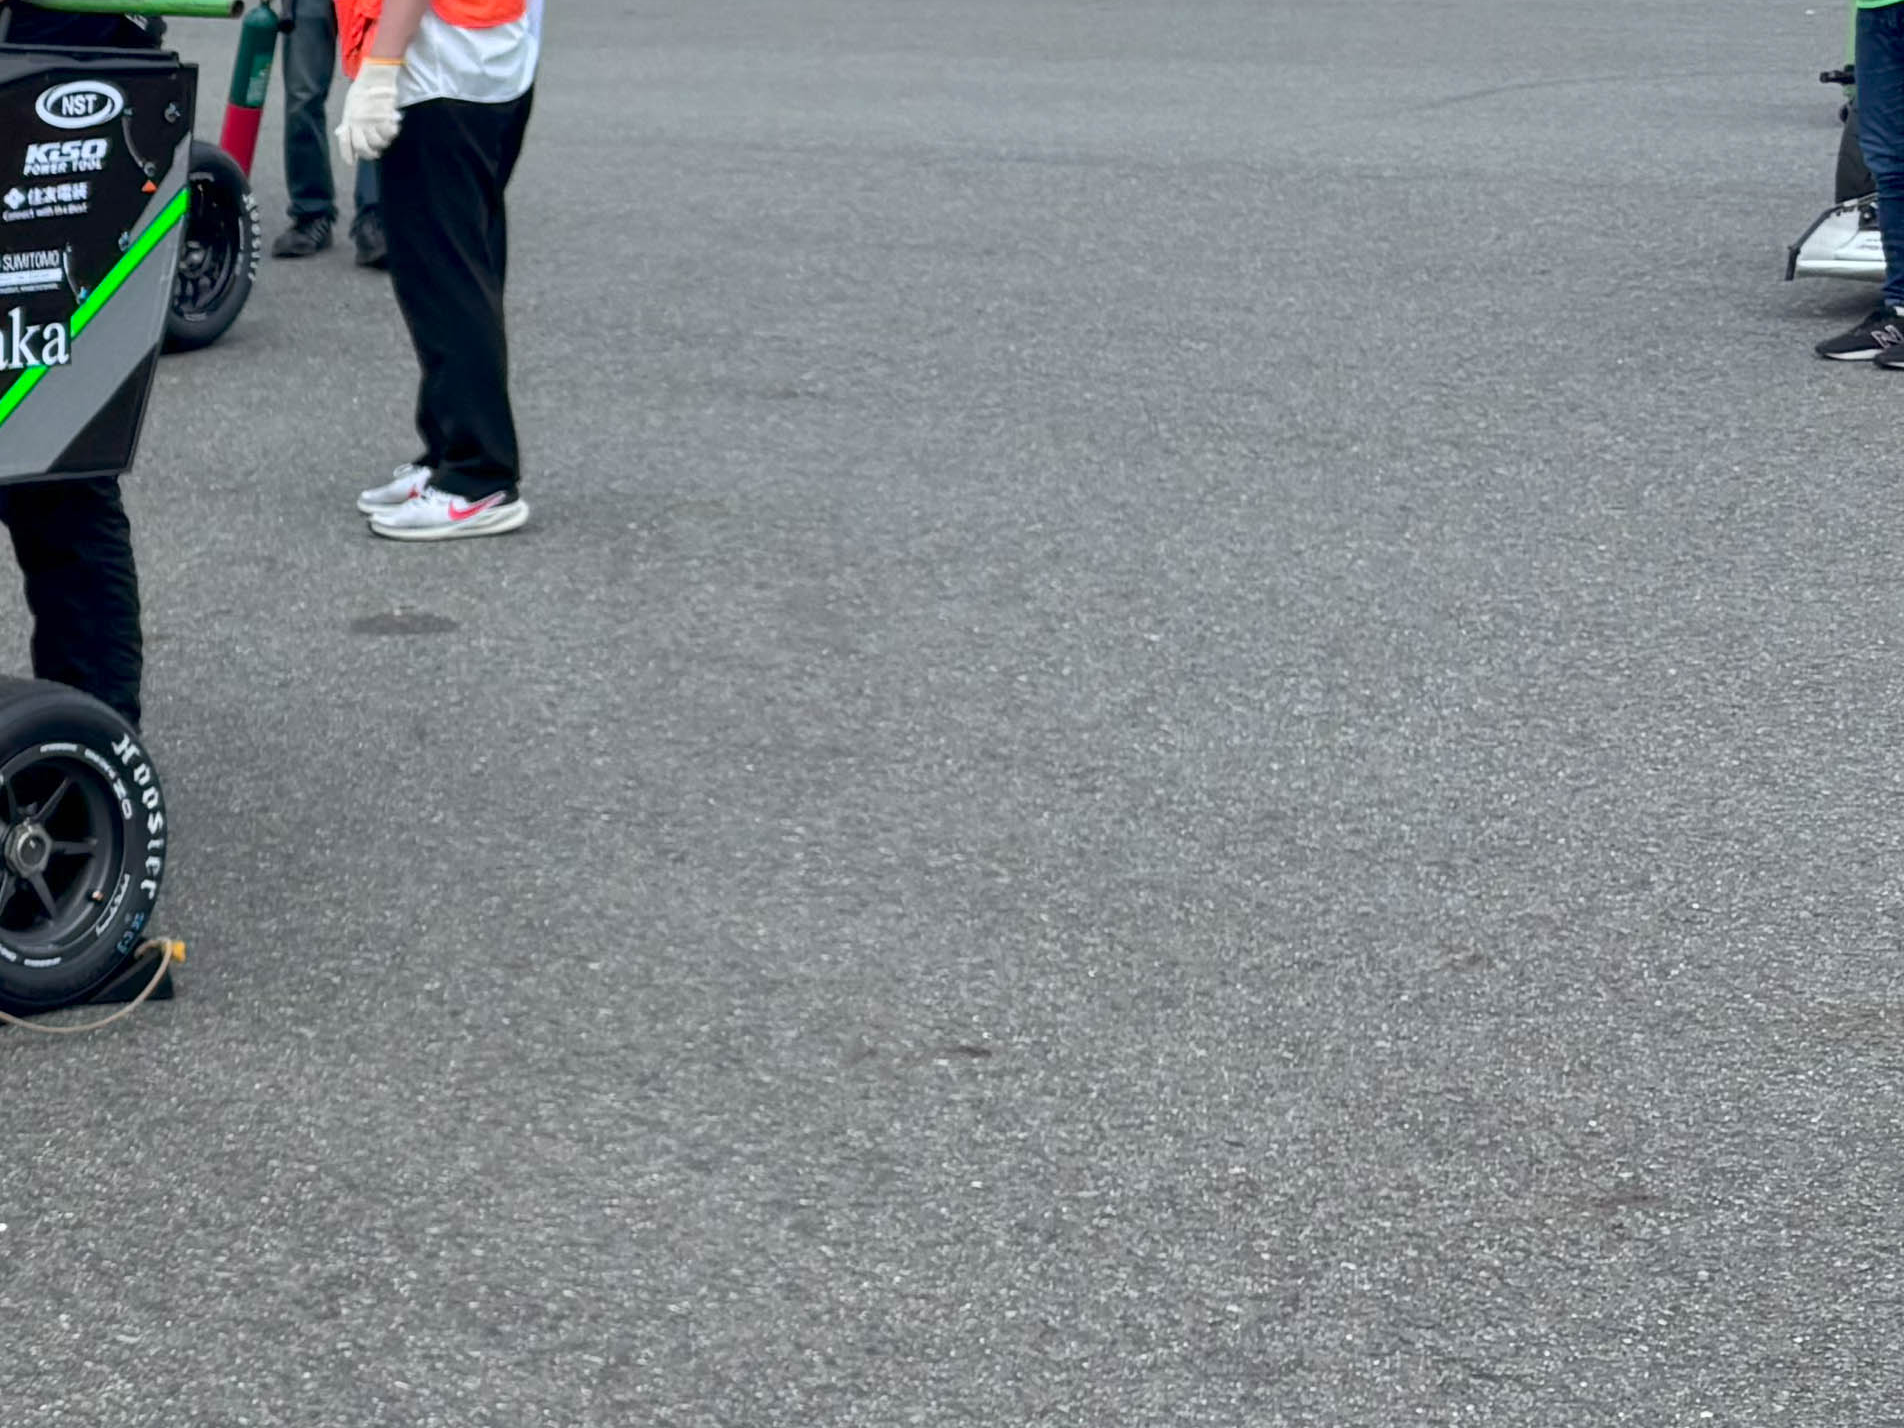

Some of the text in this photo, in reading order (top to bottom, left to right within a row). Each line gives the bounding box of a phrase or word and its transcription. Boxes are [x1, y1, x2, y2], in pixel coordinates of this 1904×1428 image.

[60, 94, 98, 117] NST
[2, 249, 60, 272] SUMITOMO
[112, 733, 165, 901] Hoosier
